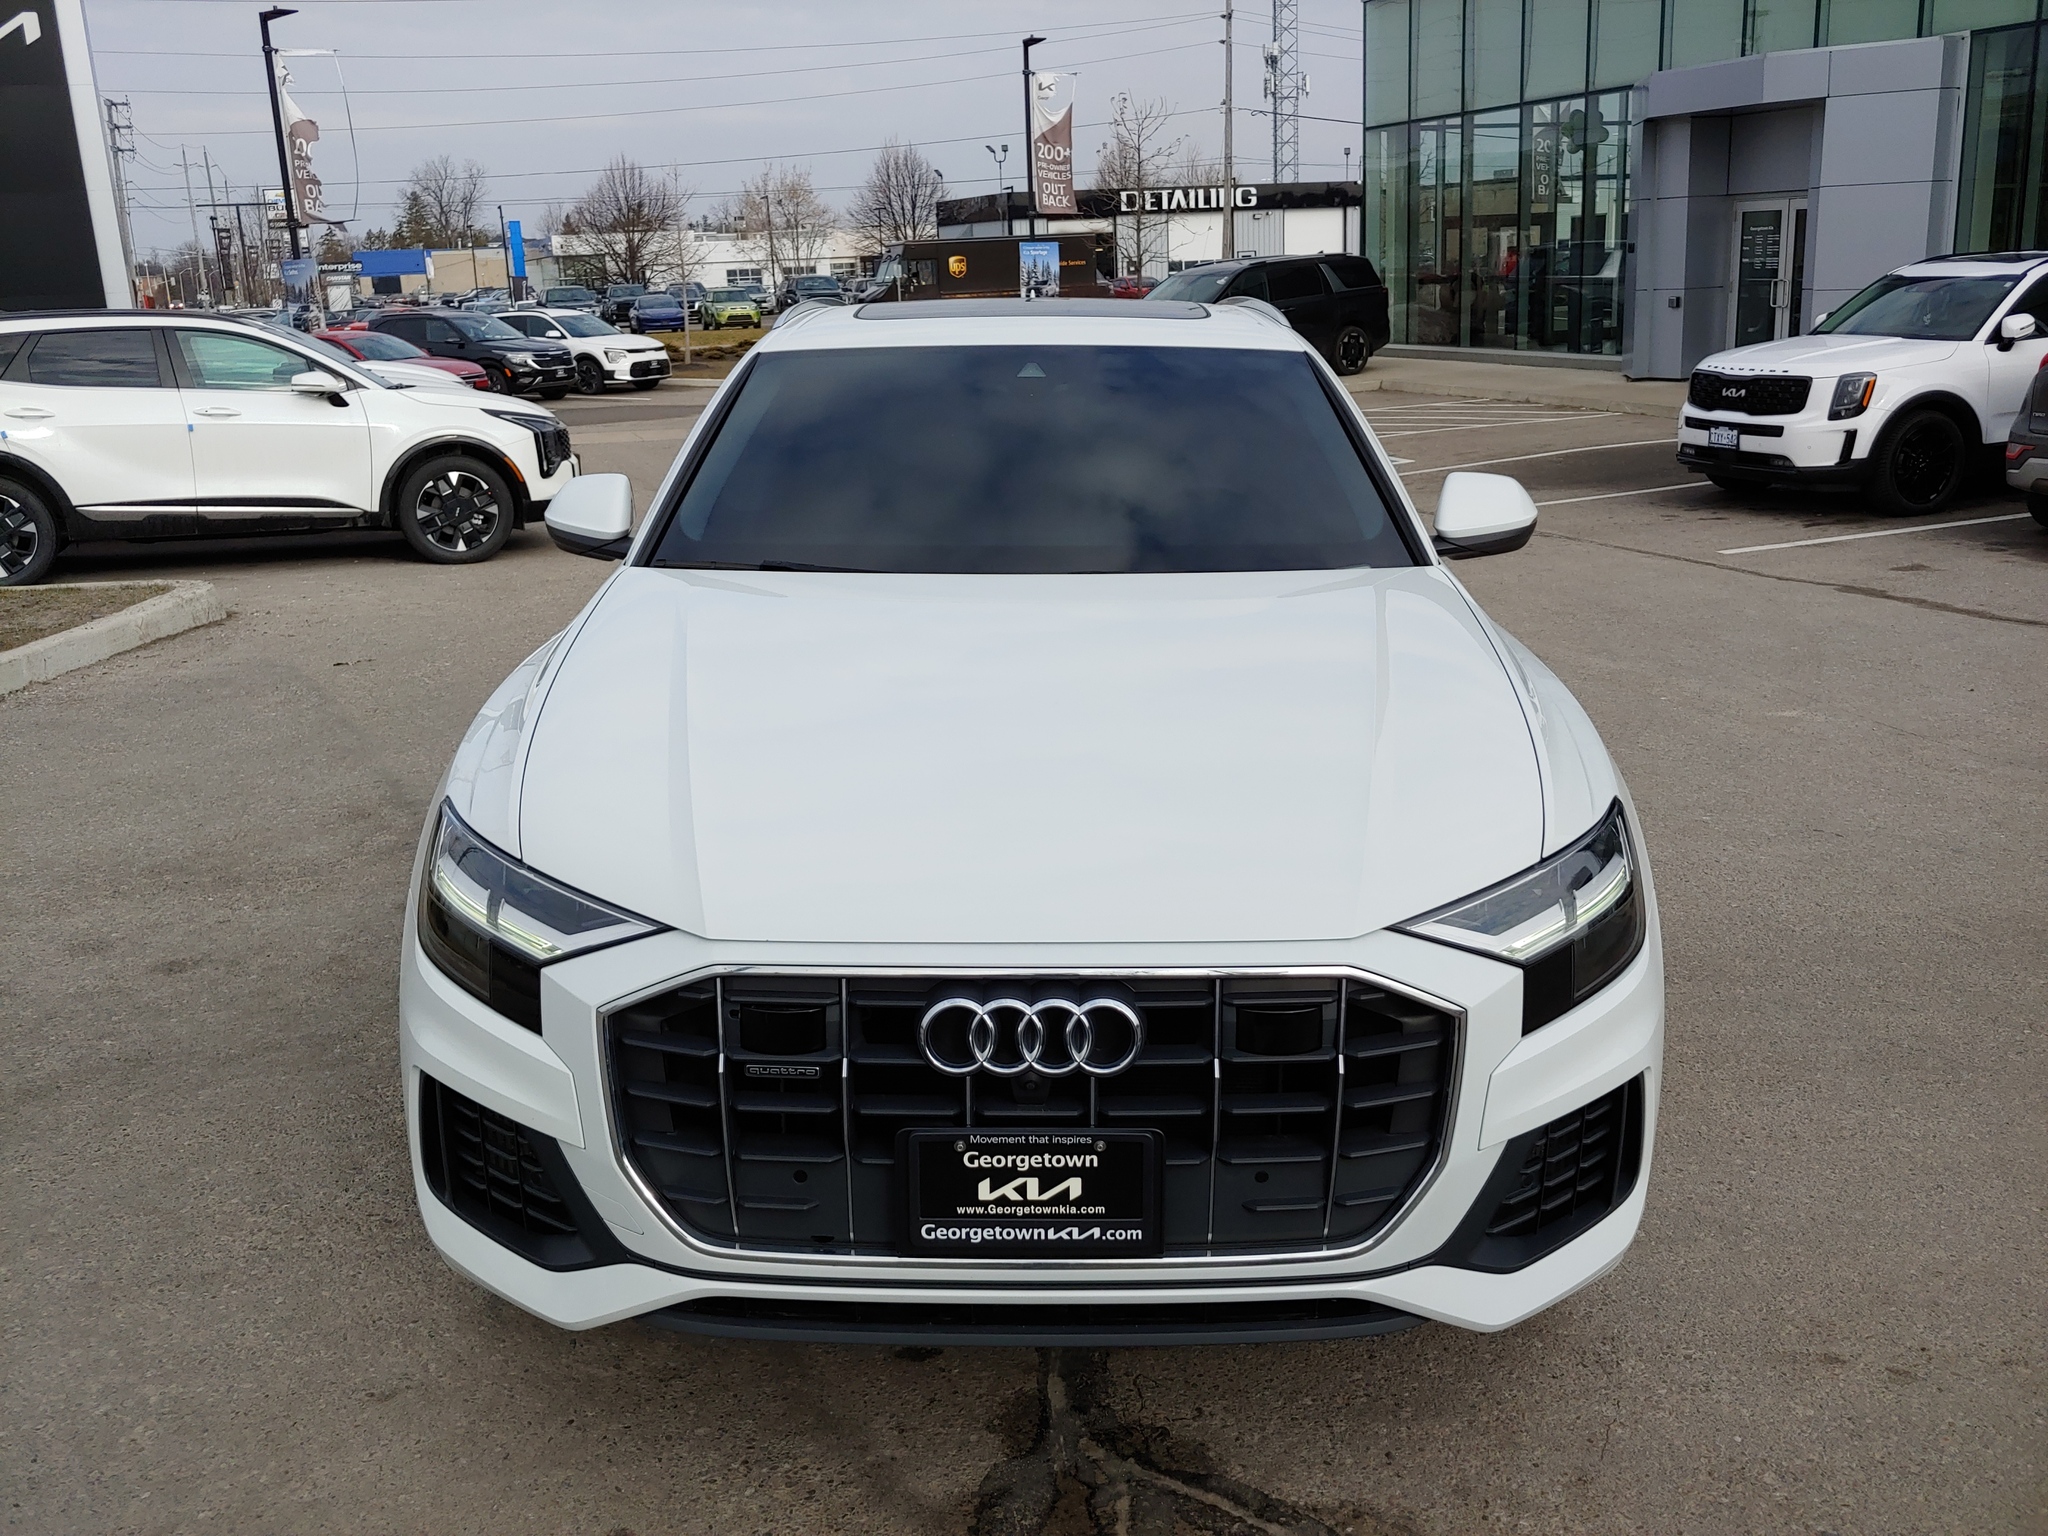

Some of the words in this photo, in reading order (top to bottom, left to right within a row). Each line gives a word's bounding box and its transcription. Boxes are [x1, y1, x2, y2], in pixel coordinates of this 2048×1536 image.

[1037, 143, 1071, 161] 200+
[1037, 161, 1070, 171] PRE-OWNED
[1037, 169, 1072, 181] VEHICLES
[1043, 182, 1066, 195] OUT
[1042, 193, 1072, 207] BACK
[318, 262, 363, 271] nterprise
[1722, 387, 1746, 397] KIA
[749, 1067, 816, 1075] quattro
[970, 1135, 1026, 1144] Movement
[1028, 1135, 1049, 1144] that
[1052, 1135, 1092, 1146] inspires
[963, 1151, 1099, 1171] Georgetown
[978, 1177, 1082, 1201] KIA
[956, 1204, 1106, 1216] www.Georgetownkia.com
